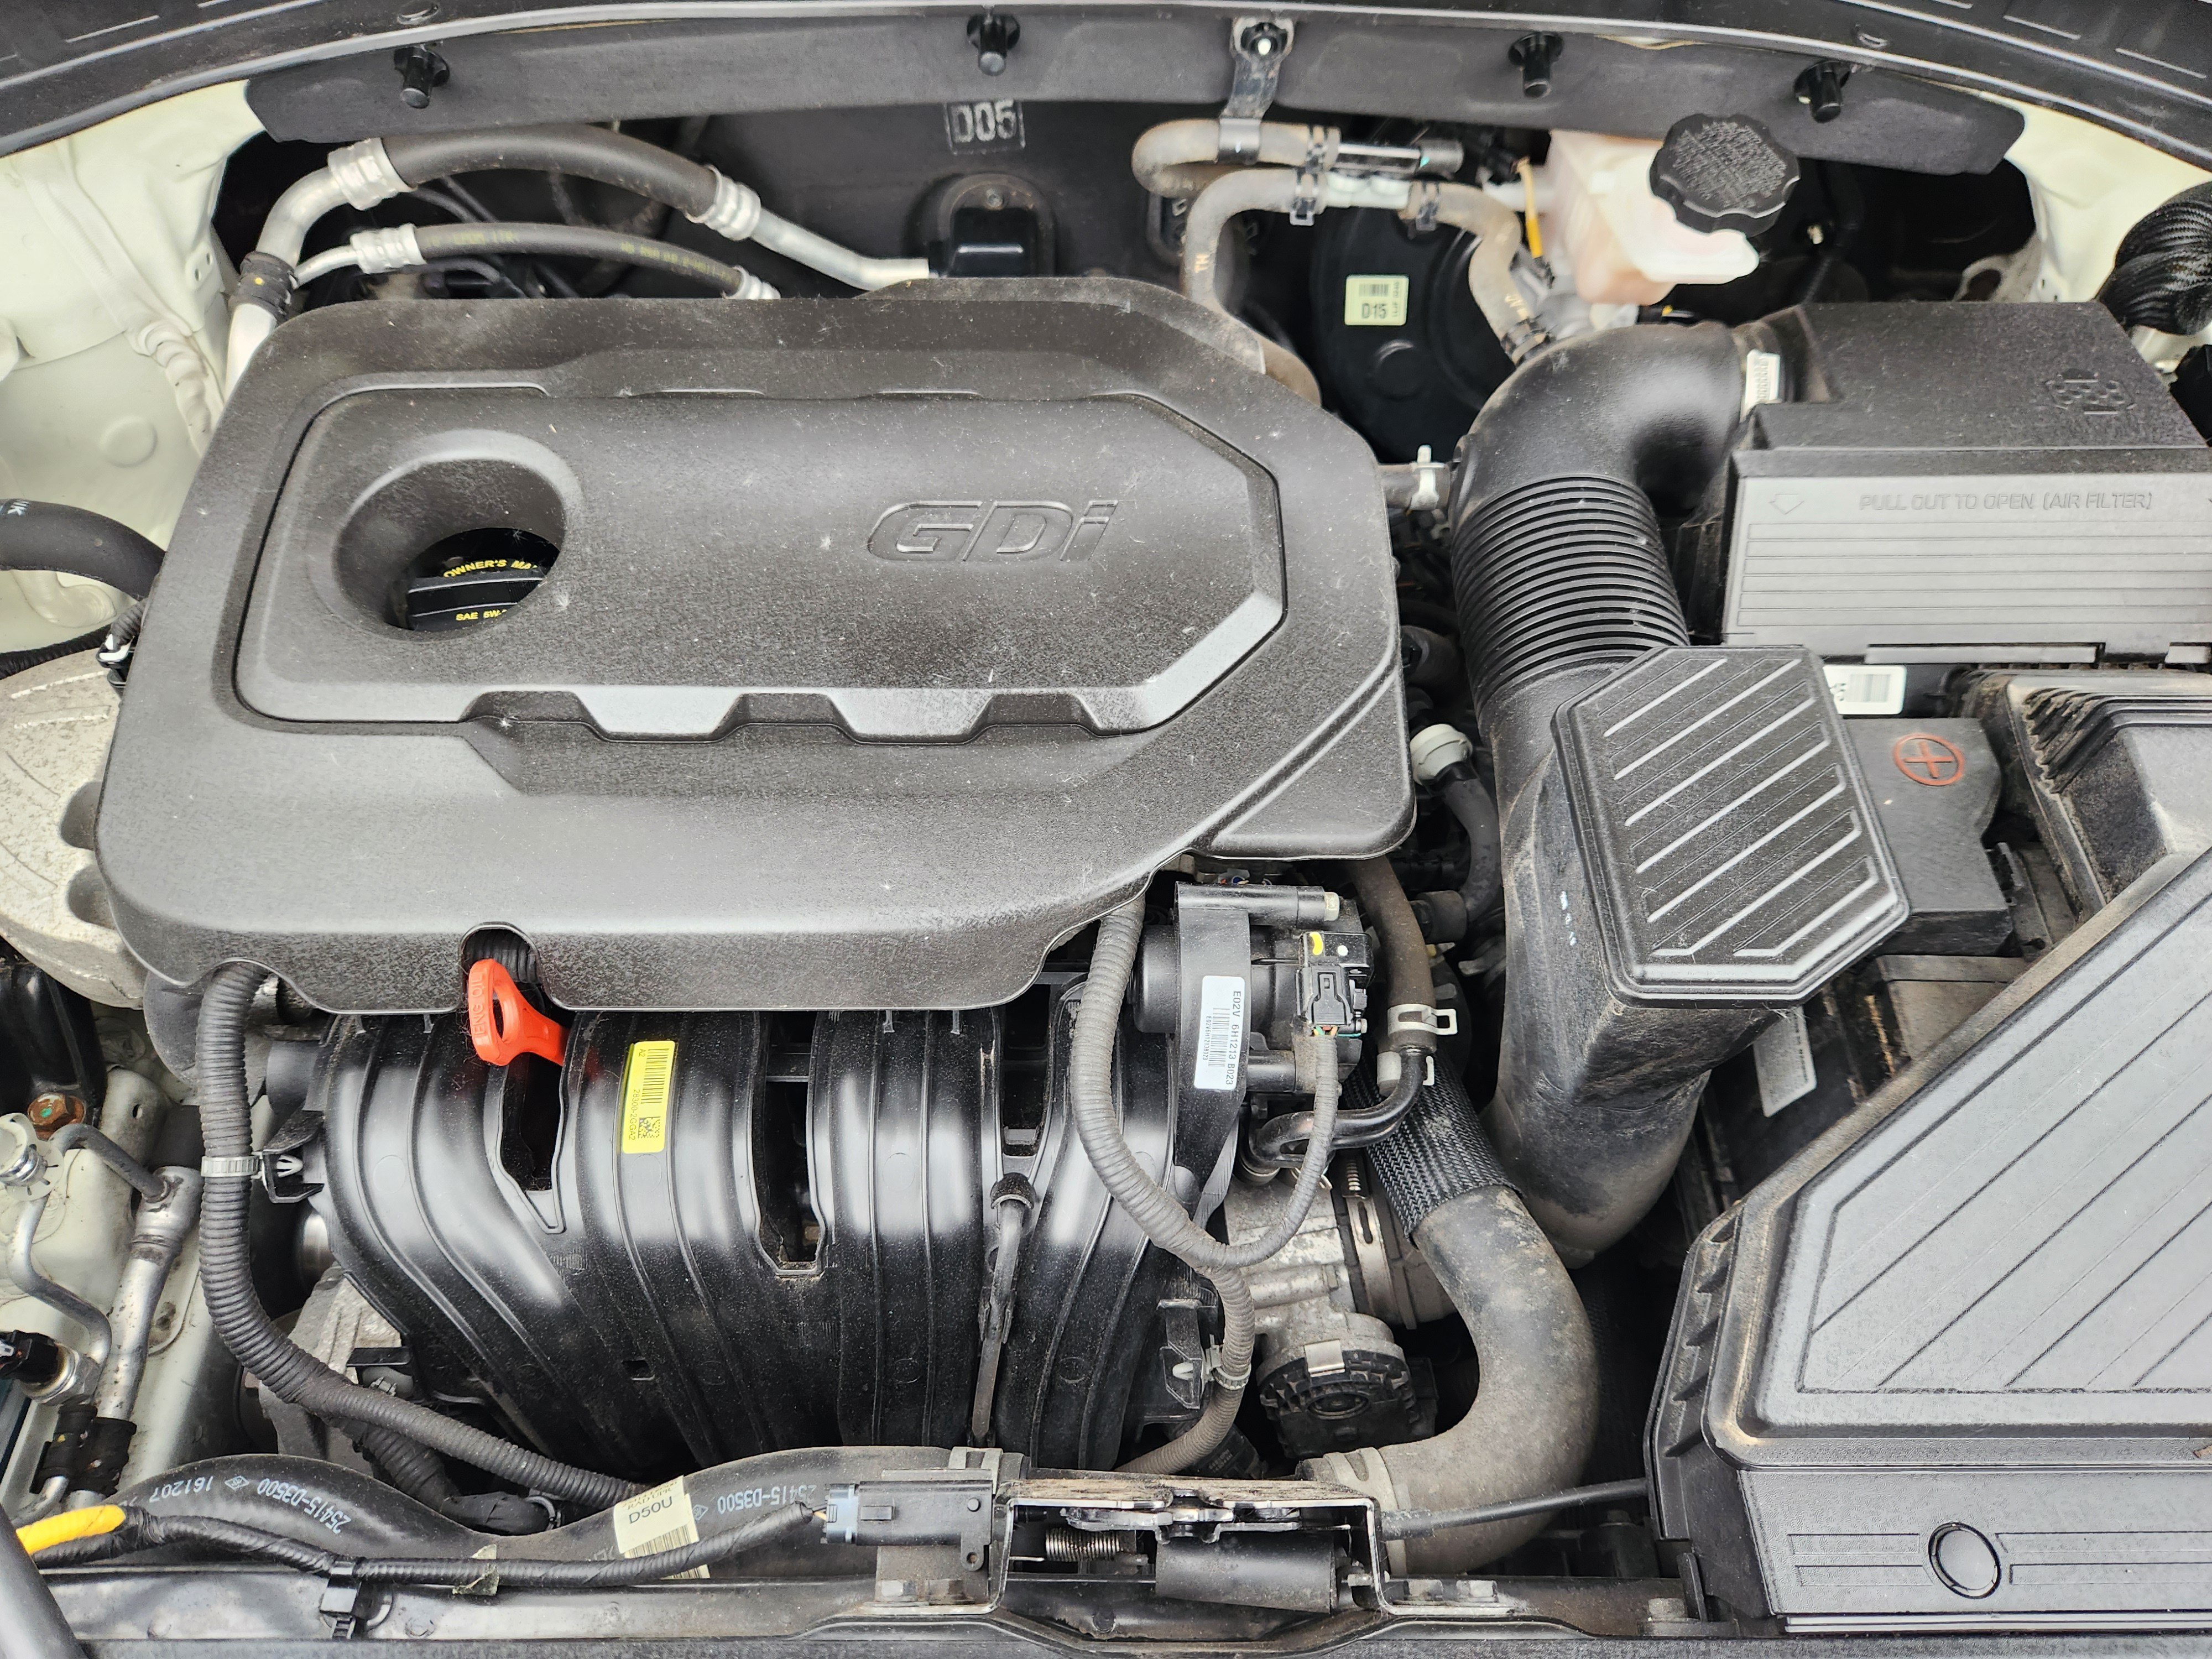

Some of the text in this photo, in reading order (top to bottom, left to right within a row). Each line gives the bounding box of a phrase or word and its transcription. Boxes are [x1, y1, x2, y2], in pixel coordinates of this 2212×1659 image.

[1361, 302, 1387, 319] D15
[1860, 494, 1907, 510] PULL
[1911, 494, 1951, 510] OUT
[1954, 494, 1978, 509] TO
[1984, 493, 2034, 509] OPEN
[444, 559, 507, 577] OWNER'S
[456, 612, 478, 621] SAE
[470, 970, 488, 1037] ENG OIL
[1226, 990, 1241, 1086] E02V 6H1213 B023
[638, 1048, 646, 1057] A2
[628, 1089, 640, 1140] 28300-2GGA2
[149, 1475, 352, 1535] 25415-D3500 161207
